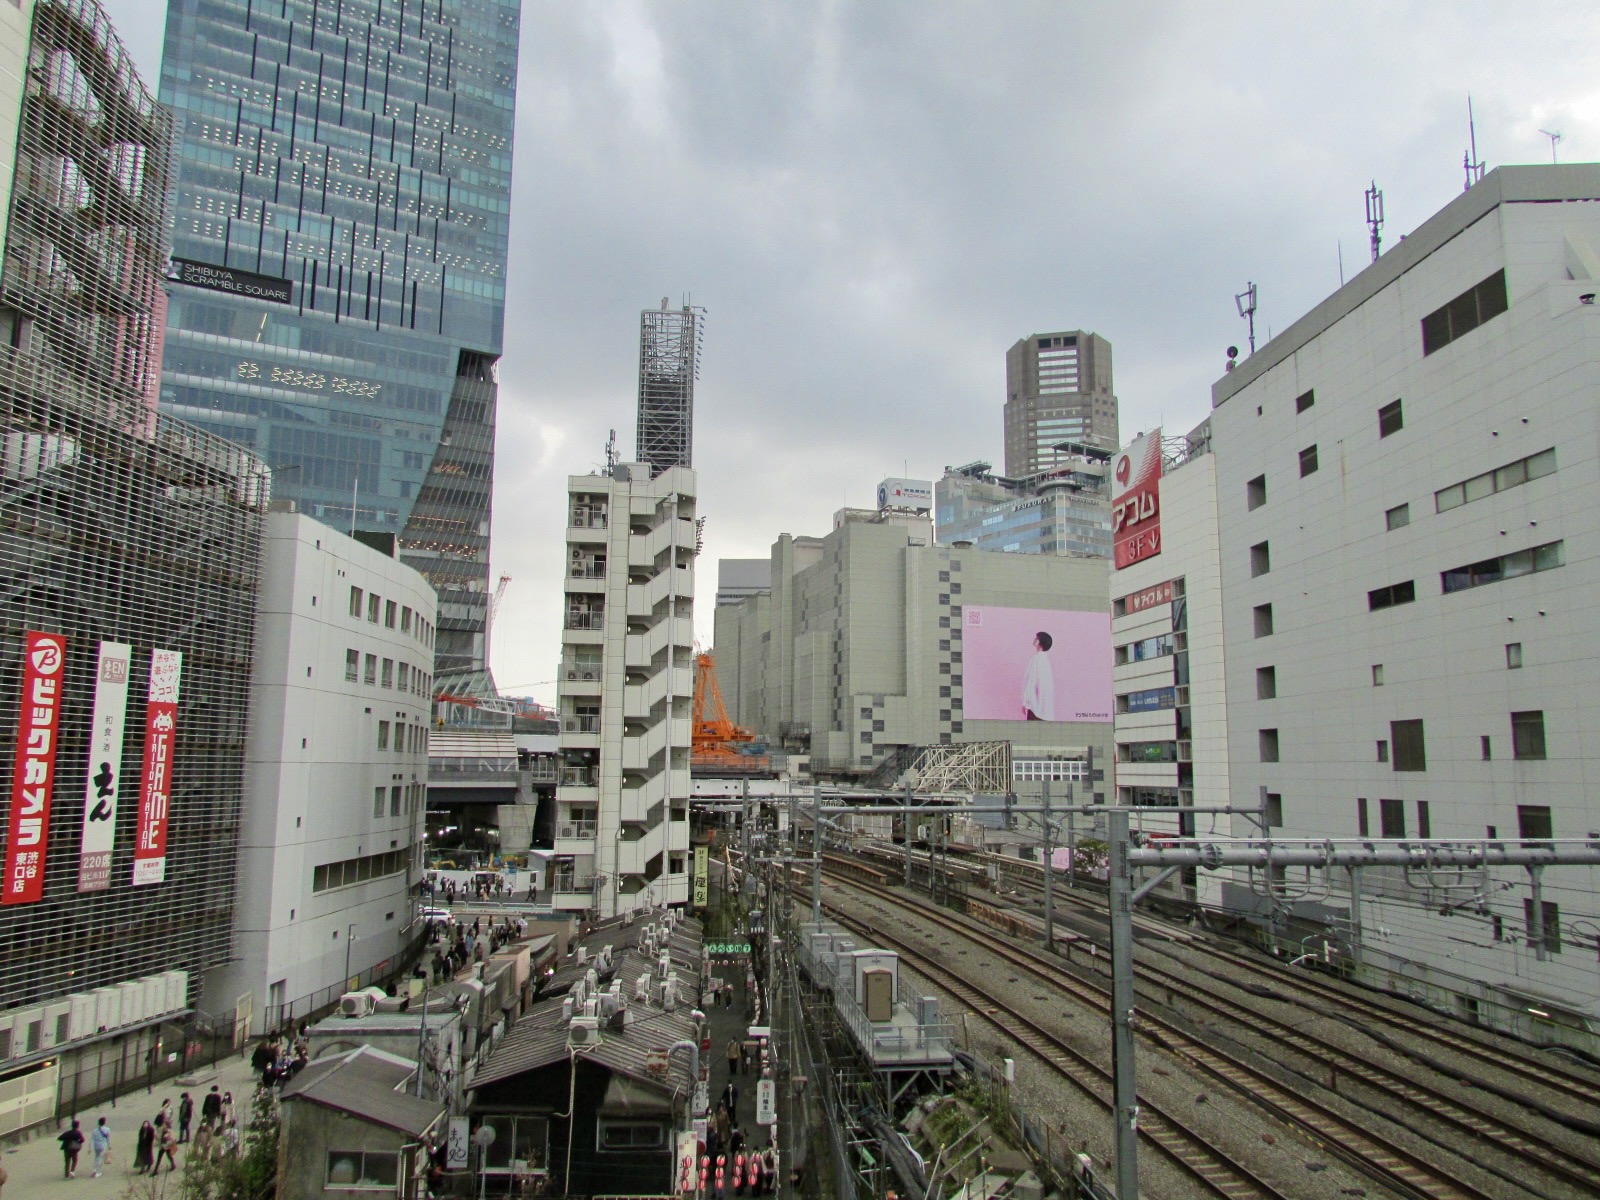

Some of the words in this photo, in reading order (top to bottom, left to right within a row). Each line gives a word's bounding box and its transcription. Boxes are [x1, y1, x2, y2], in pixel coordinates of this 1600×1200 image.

[184, 273, 243, 292] SCRAMBLE
[245, 284, 288, 302] SQUARE
[186, 264, 233, 280] SHIBUYA
[1112, 491, 1156, 534] アコム
[1128, 533, 1146, 560] 3F
[112, 661, 125, 676] EN
[17, 677, 56, 846] ビックカメラ
[147, 734, 157, 781] TAITO
[89, 761, 114, 823] えん
[148, 734, 168, 849] GAME
[141, 784, 153, 849] STATION
[13, 852, 28, 893] 東口店
[26, 851, 39, 878] 渋谷
[83, 853, 112, 870] 220席
